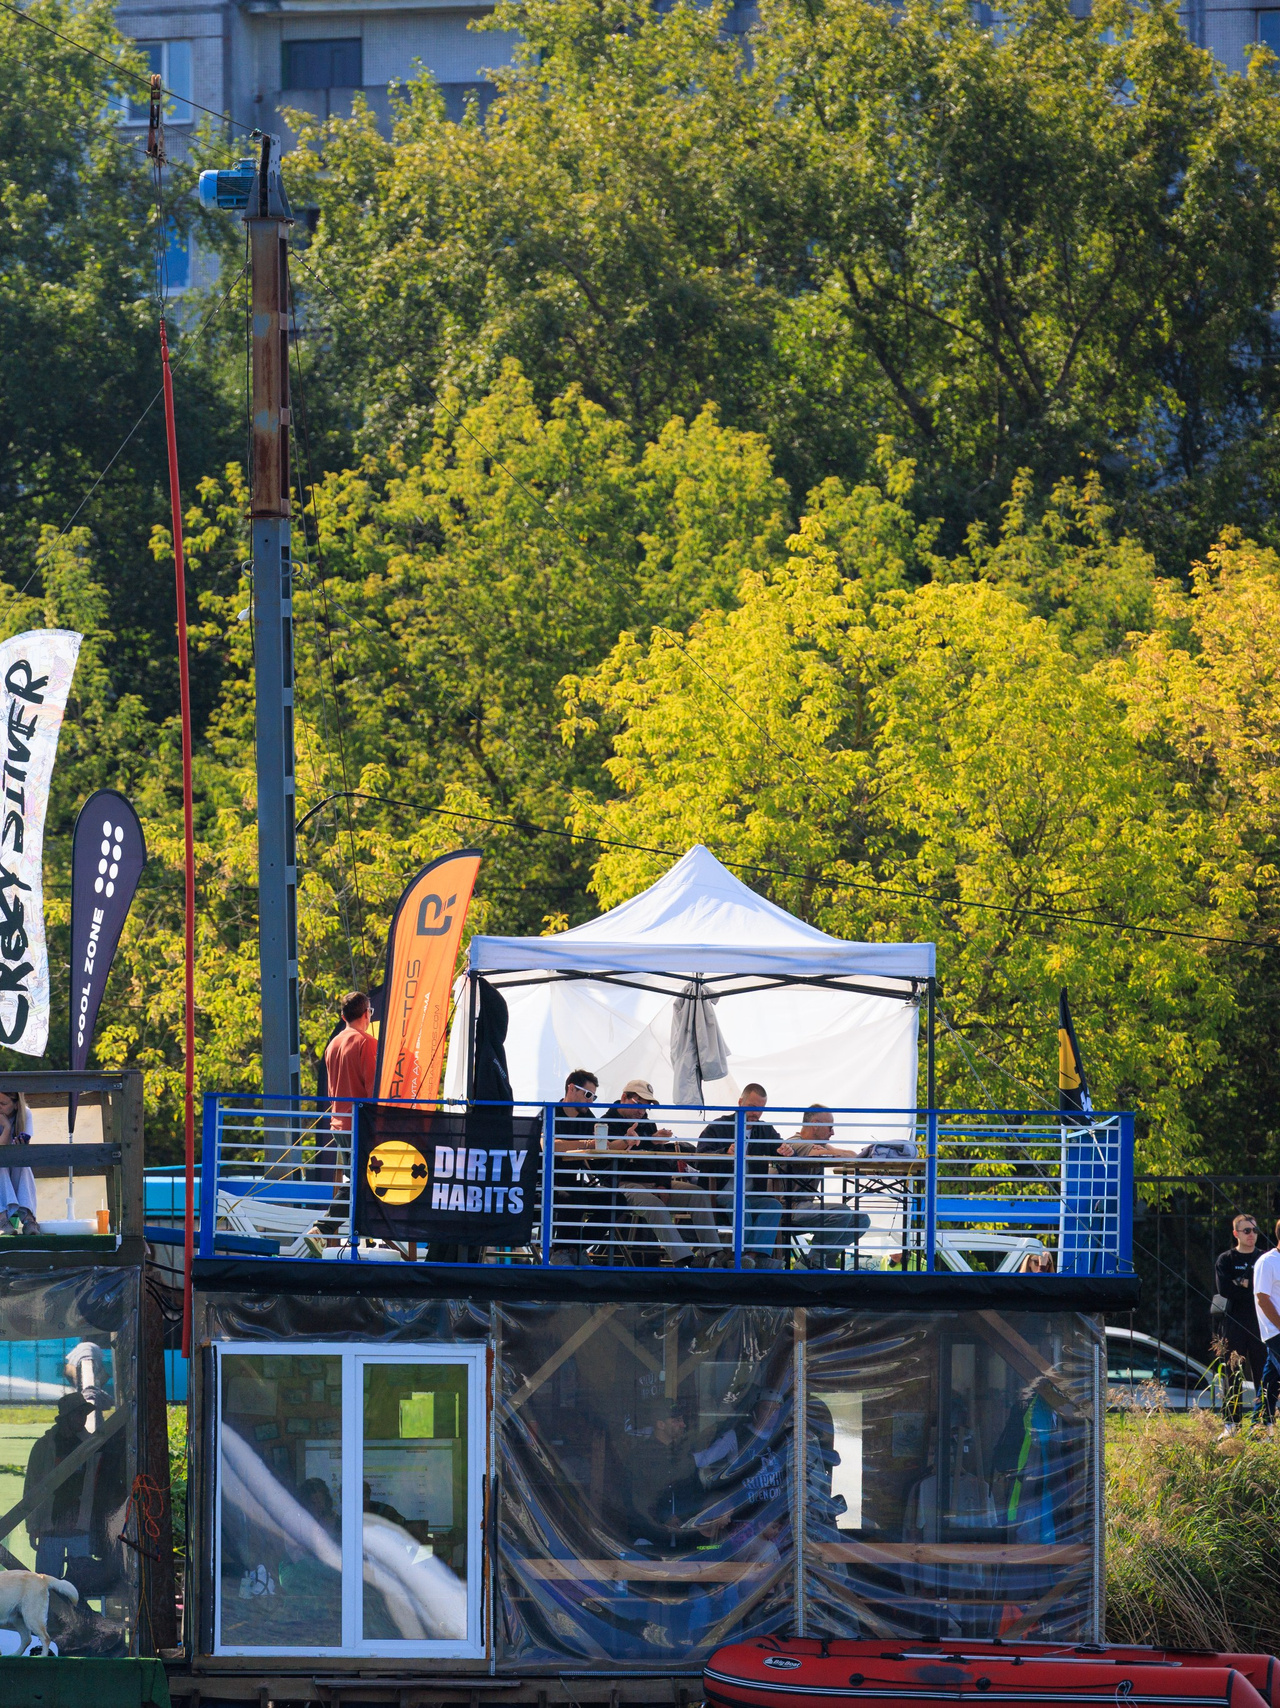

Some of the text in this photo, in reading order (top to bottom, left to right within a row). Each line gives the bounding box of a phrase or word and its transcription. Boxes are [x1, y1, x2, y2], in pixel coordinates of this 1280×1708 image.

[84, 907, 105, 976] ZONE
[434, 1145, 528, 1182] DIRTY
[431, 1183, 524, 1214] HABITS
[784, 1660, 801, 1668] Boat
